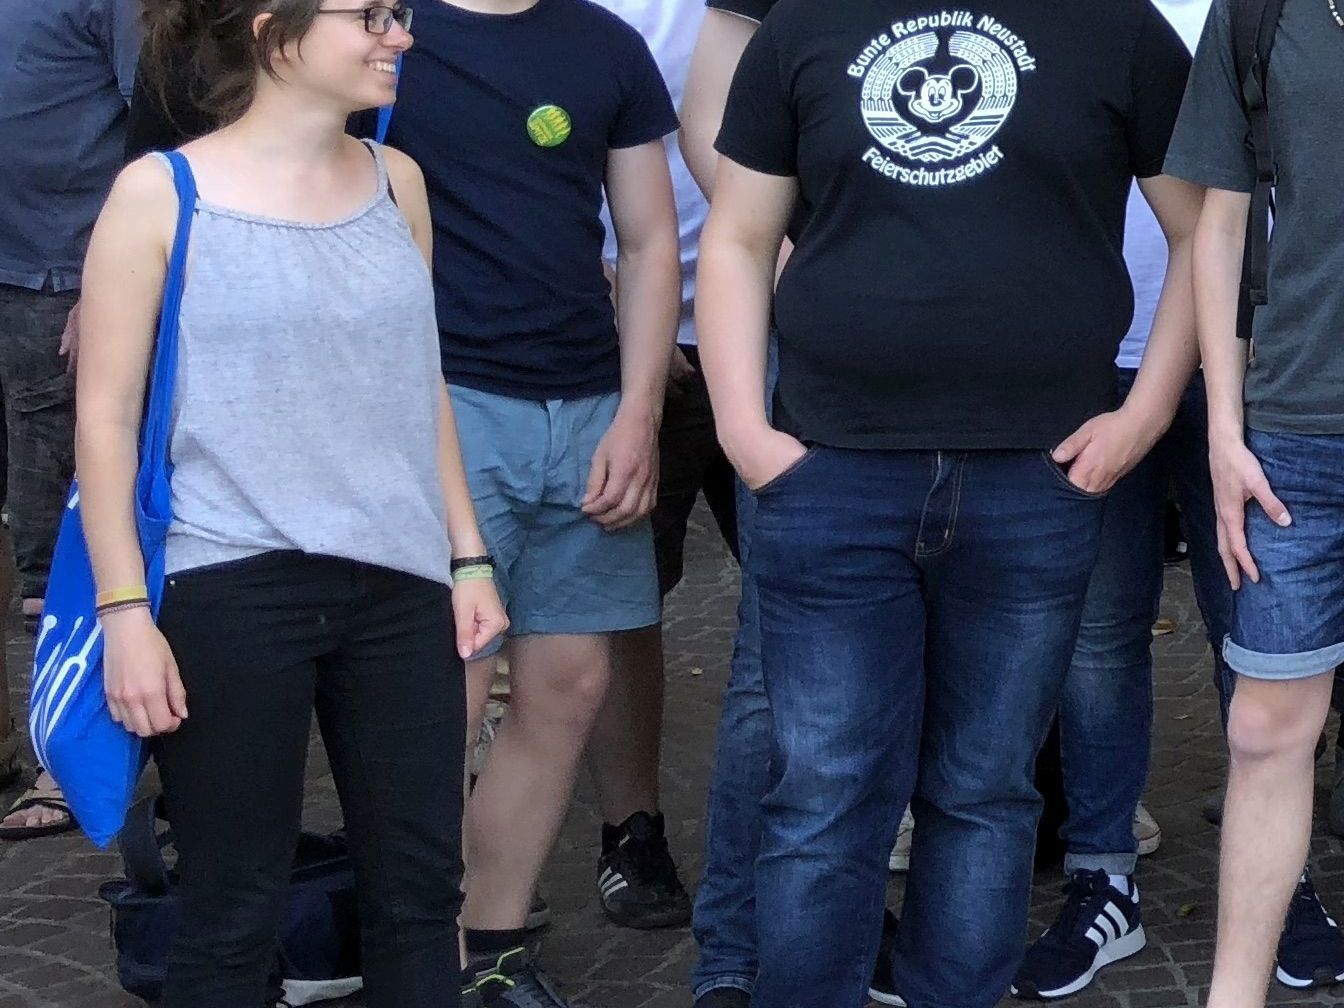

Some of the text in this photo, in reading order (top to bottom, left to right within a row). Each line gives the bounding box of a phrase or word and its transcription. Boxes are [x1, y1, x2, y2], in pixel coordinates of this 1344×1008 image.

[847, 10, 1037, 79] Bunte Republik Neustadt
[861, 144, 1005, 187] Feierschutzgebiet
